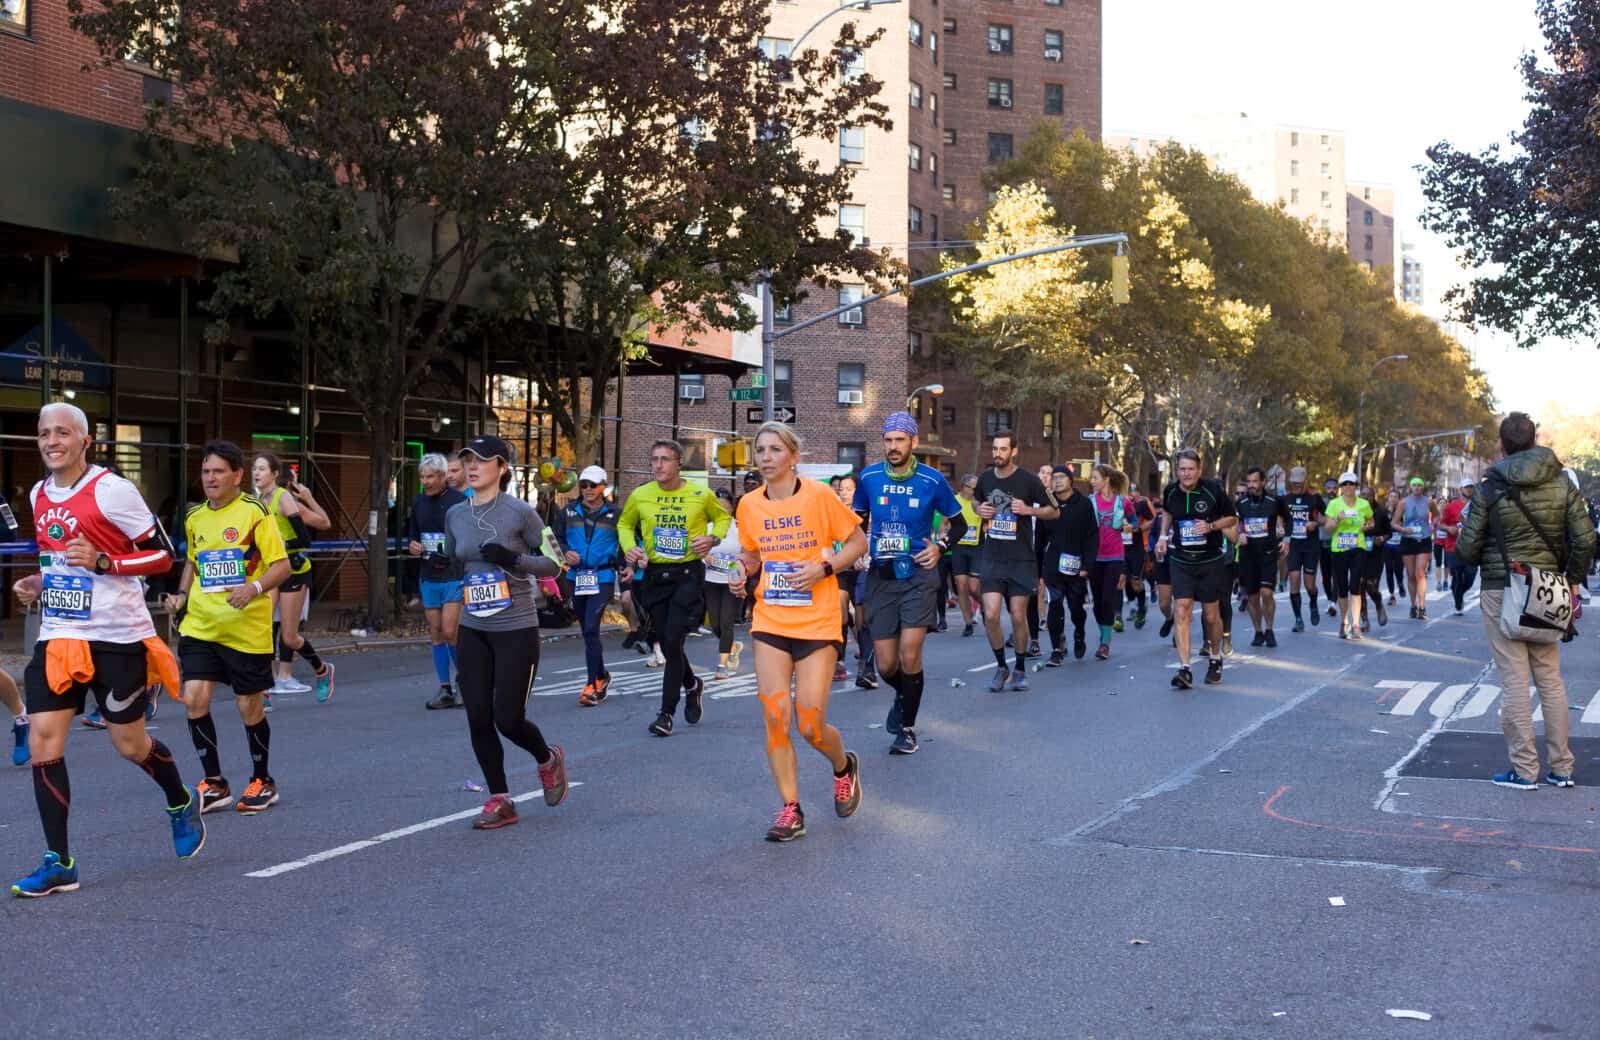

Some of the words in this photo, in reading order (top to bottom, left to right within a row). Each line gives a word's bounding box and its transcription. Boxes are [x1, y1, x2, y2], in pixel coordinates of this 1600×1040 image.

[731, 390, 737, 400] W
[740, 390, 752, 400] 112
[883, 485, 913, 495] FEDE
[36, 507, 78, 532] ITALIA
[655, 514, 687, 523] TEAM
[764, 515, 802, 530] ELSKE
[797, 531, 814, 539] CITY
[205, 561, 237, 577] 35708
[49, 590, 80, 608] 55639
[471, 585, 496, 601] 13847
